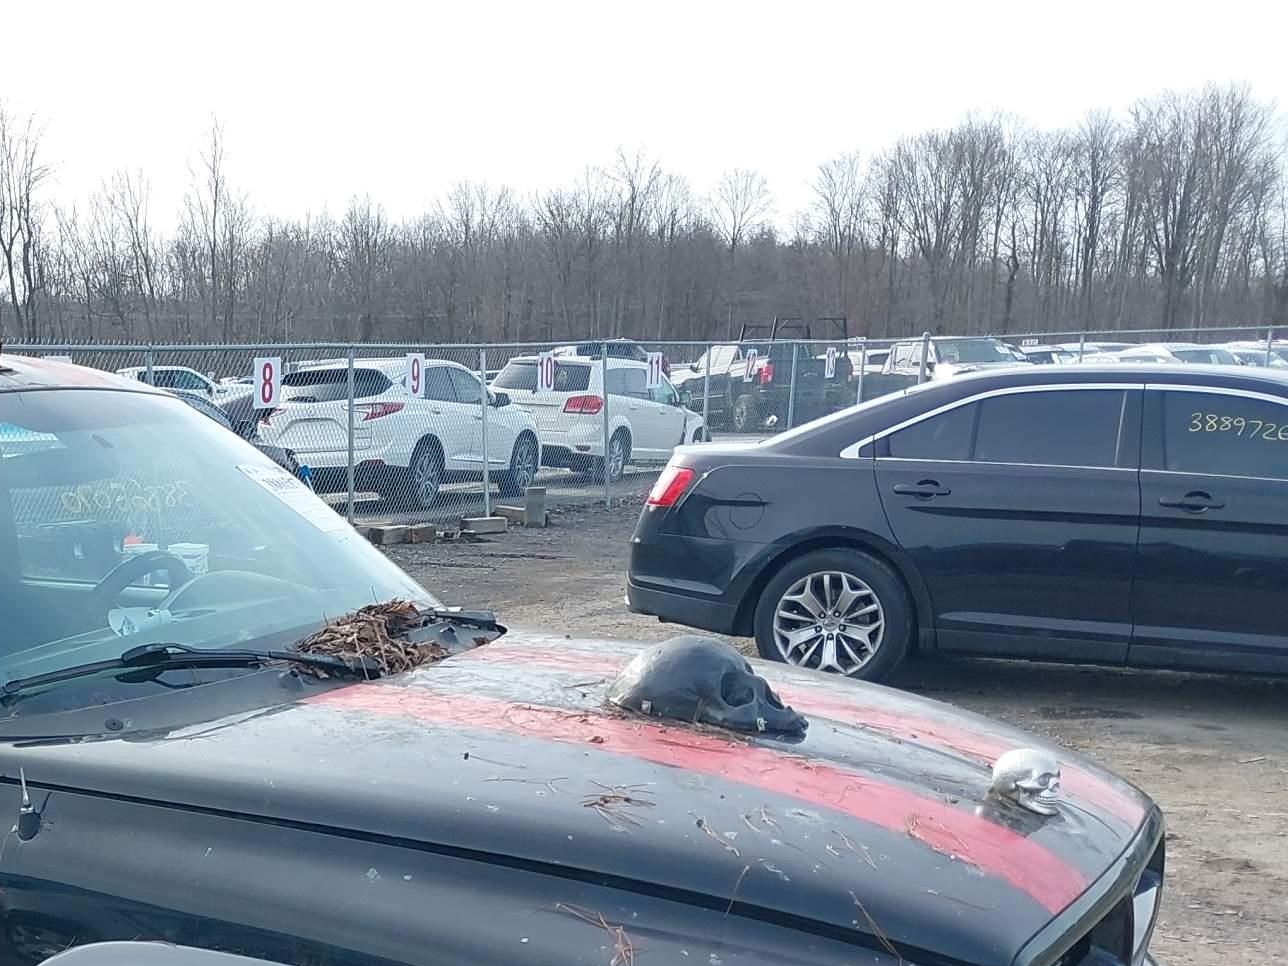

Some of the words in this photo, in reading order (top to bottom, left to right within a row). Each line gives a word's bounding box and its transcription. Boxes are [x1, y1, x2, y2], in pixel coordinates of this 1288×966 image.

[411, 358, 421, 394] 9
[539, 356, 553, 389] 10
[648, 356, 661, 386] 11
[745, 351, 757, 380] 12
[261, 362, 274, 403] 8
